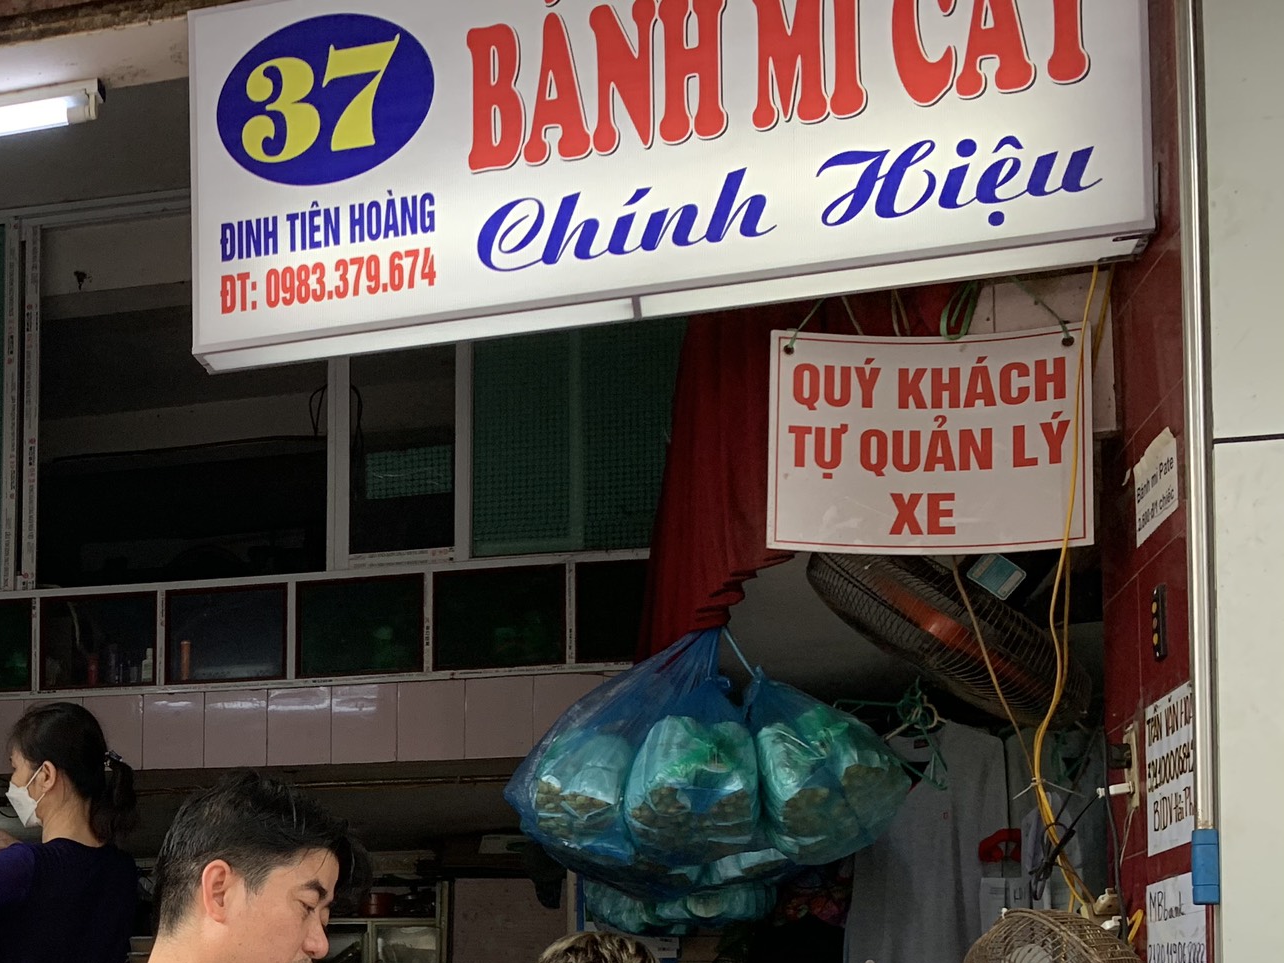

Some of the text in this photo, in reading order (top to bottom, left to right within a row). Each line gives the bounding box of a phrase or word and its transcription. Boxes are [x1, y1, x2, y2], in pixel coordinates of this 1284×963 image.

[241, 35, 400, 164] 37
[220, 189, 435, 262] ĐINH TIÊN HOÀNG
[476, 134, 1103, 272] Chính Hiệu
[220, 246, 436, 314] ĐT: 0983.379.674
[793, 356, 1066, 411] QUÝ KHÁCH
[788, 410, 1071, 480] TỰ QUẢN LÝ
[889, 492, 956, 535] XE
